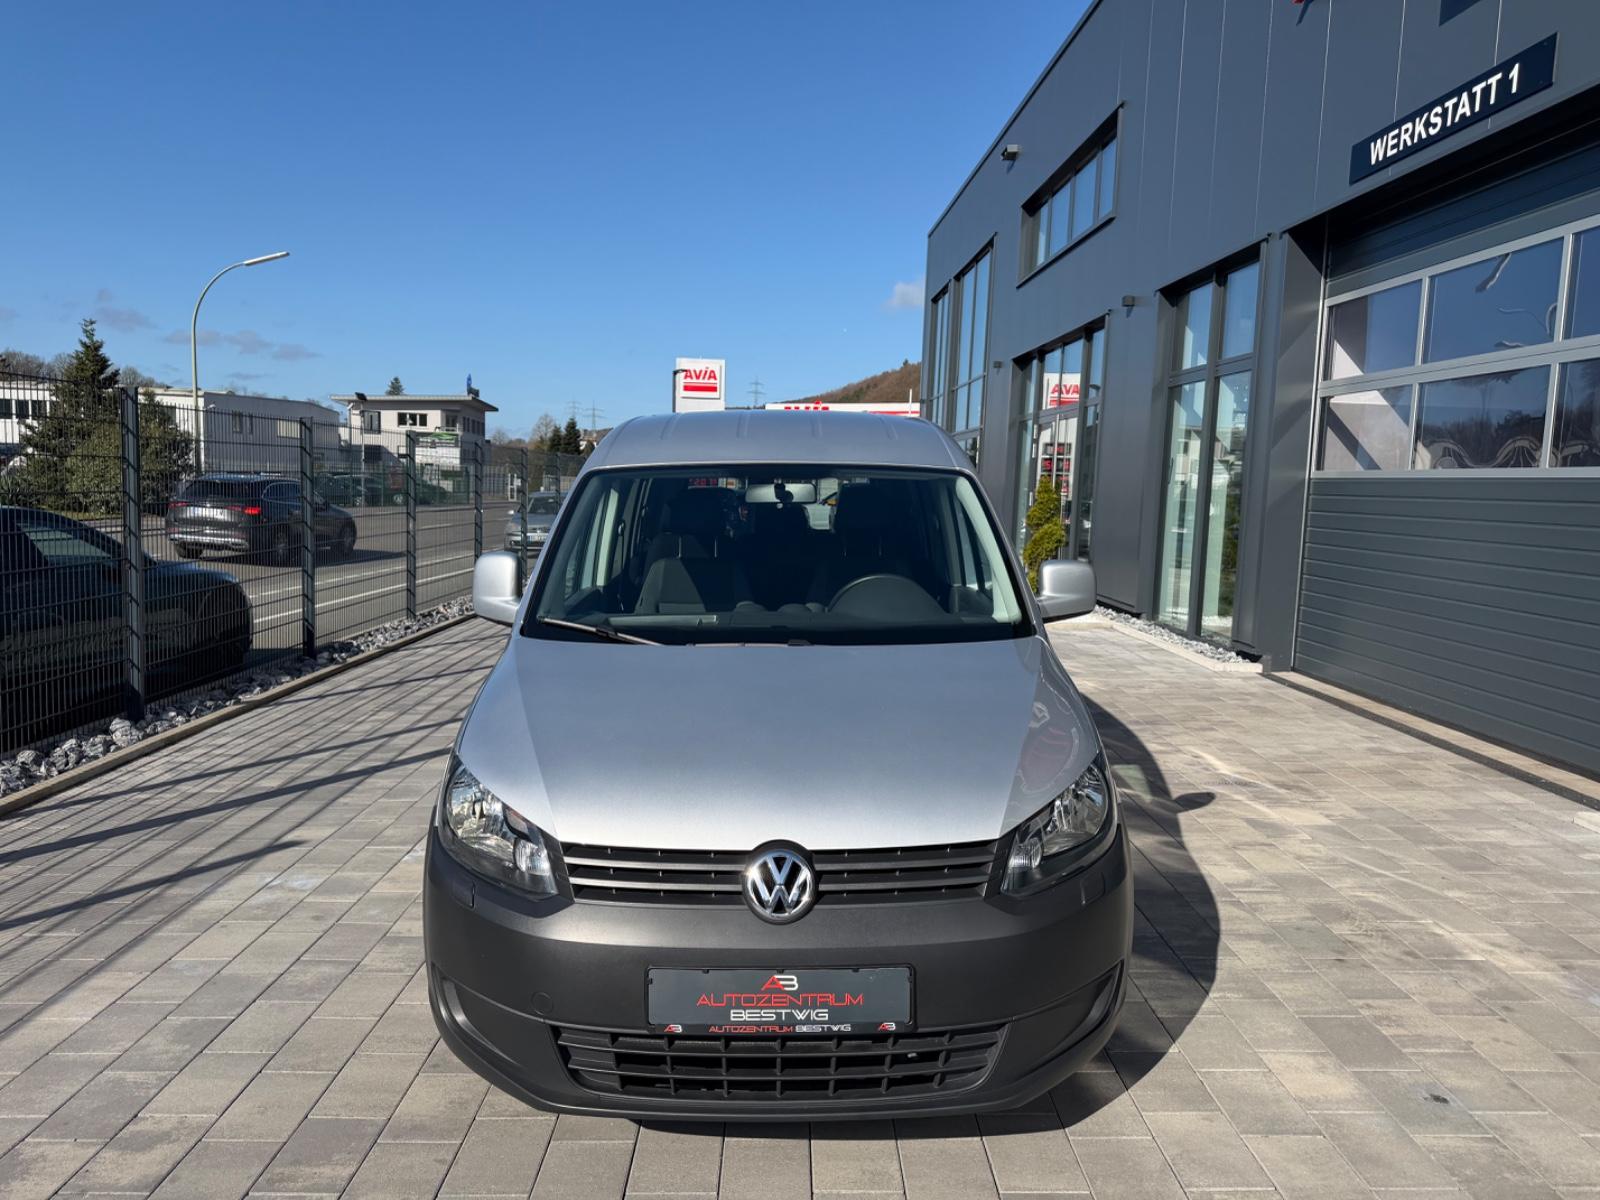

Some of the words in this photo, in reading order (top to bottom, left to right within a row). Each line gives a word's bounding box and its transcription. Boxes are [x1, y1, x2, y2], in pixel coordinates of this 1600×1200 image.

[1370, 72, 1503, 166] WERKSTATT
[1508, 62, 1520, 94] 1
[696, 992, 865, 1007] AUTOZENTRUM
[730, 1008, 829, 1021] BESTWIG
[709, 1024, 793, 1033] AUTOZENTRUM
[795, 1023, 852, 1032] BESTWIG
